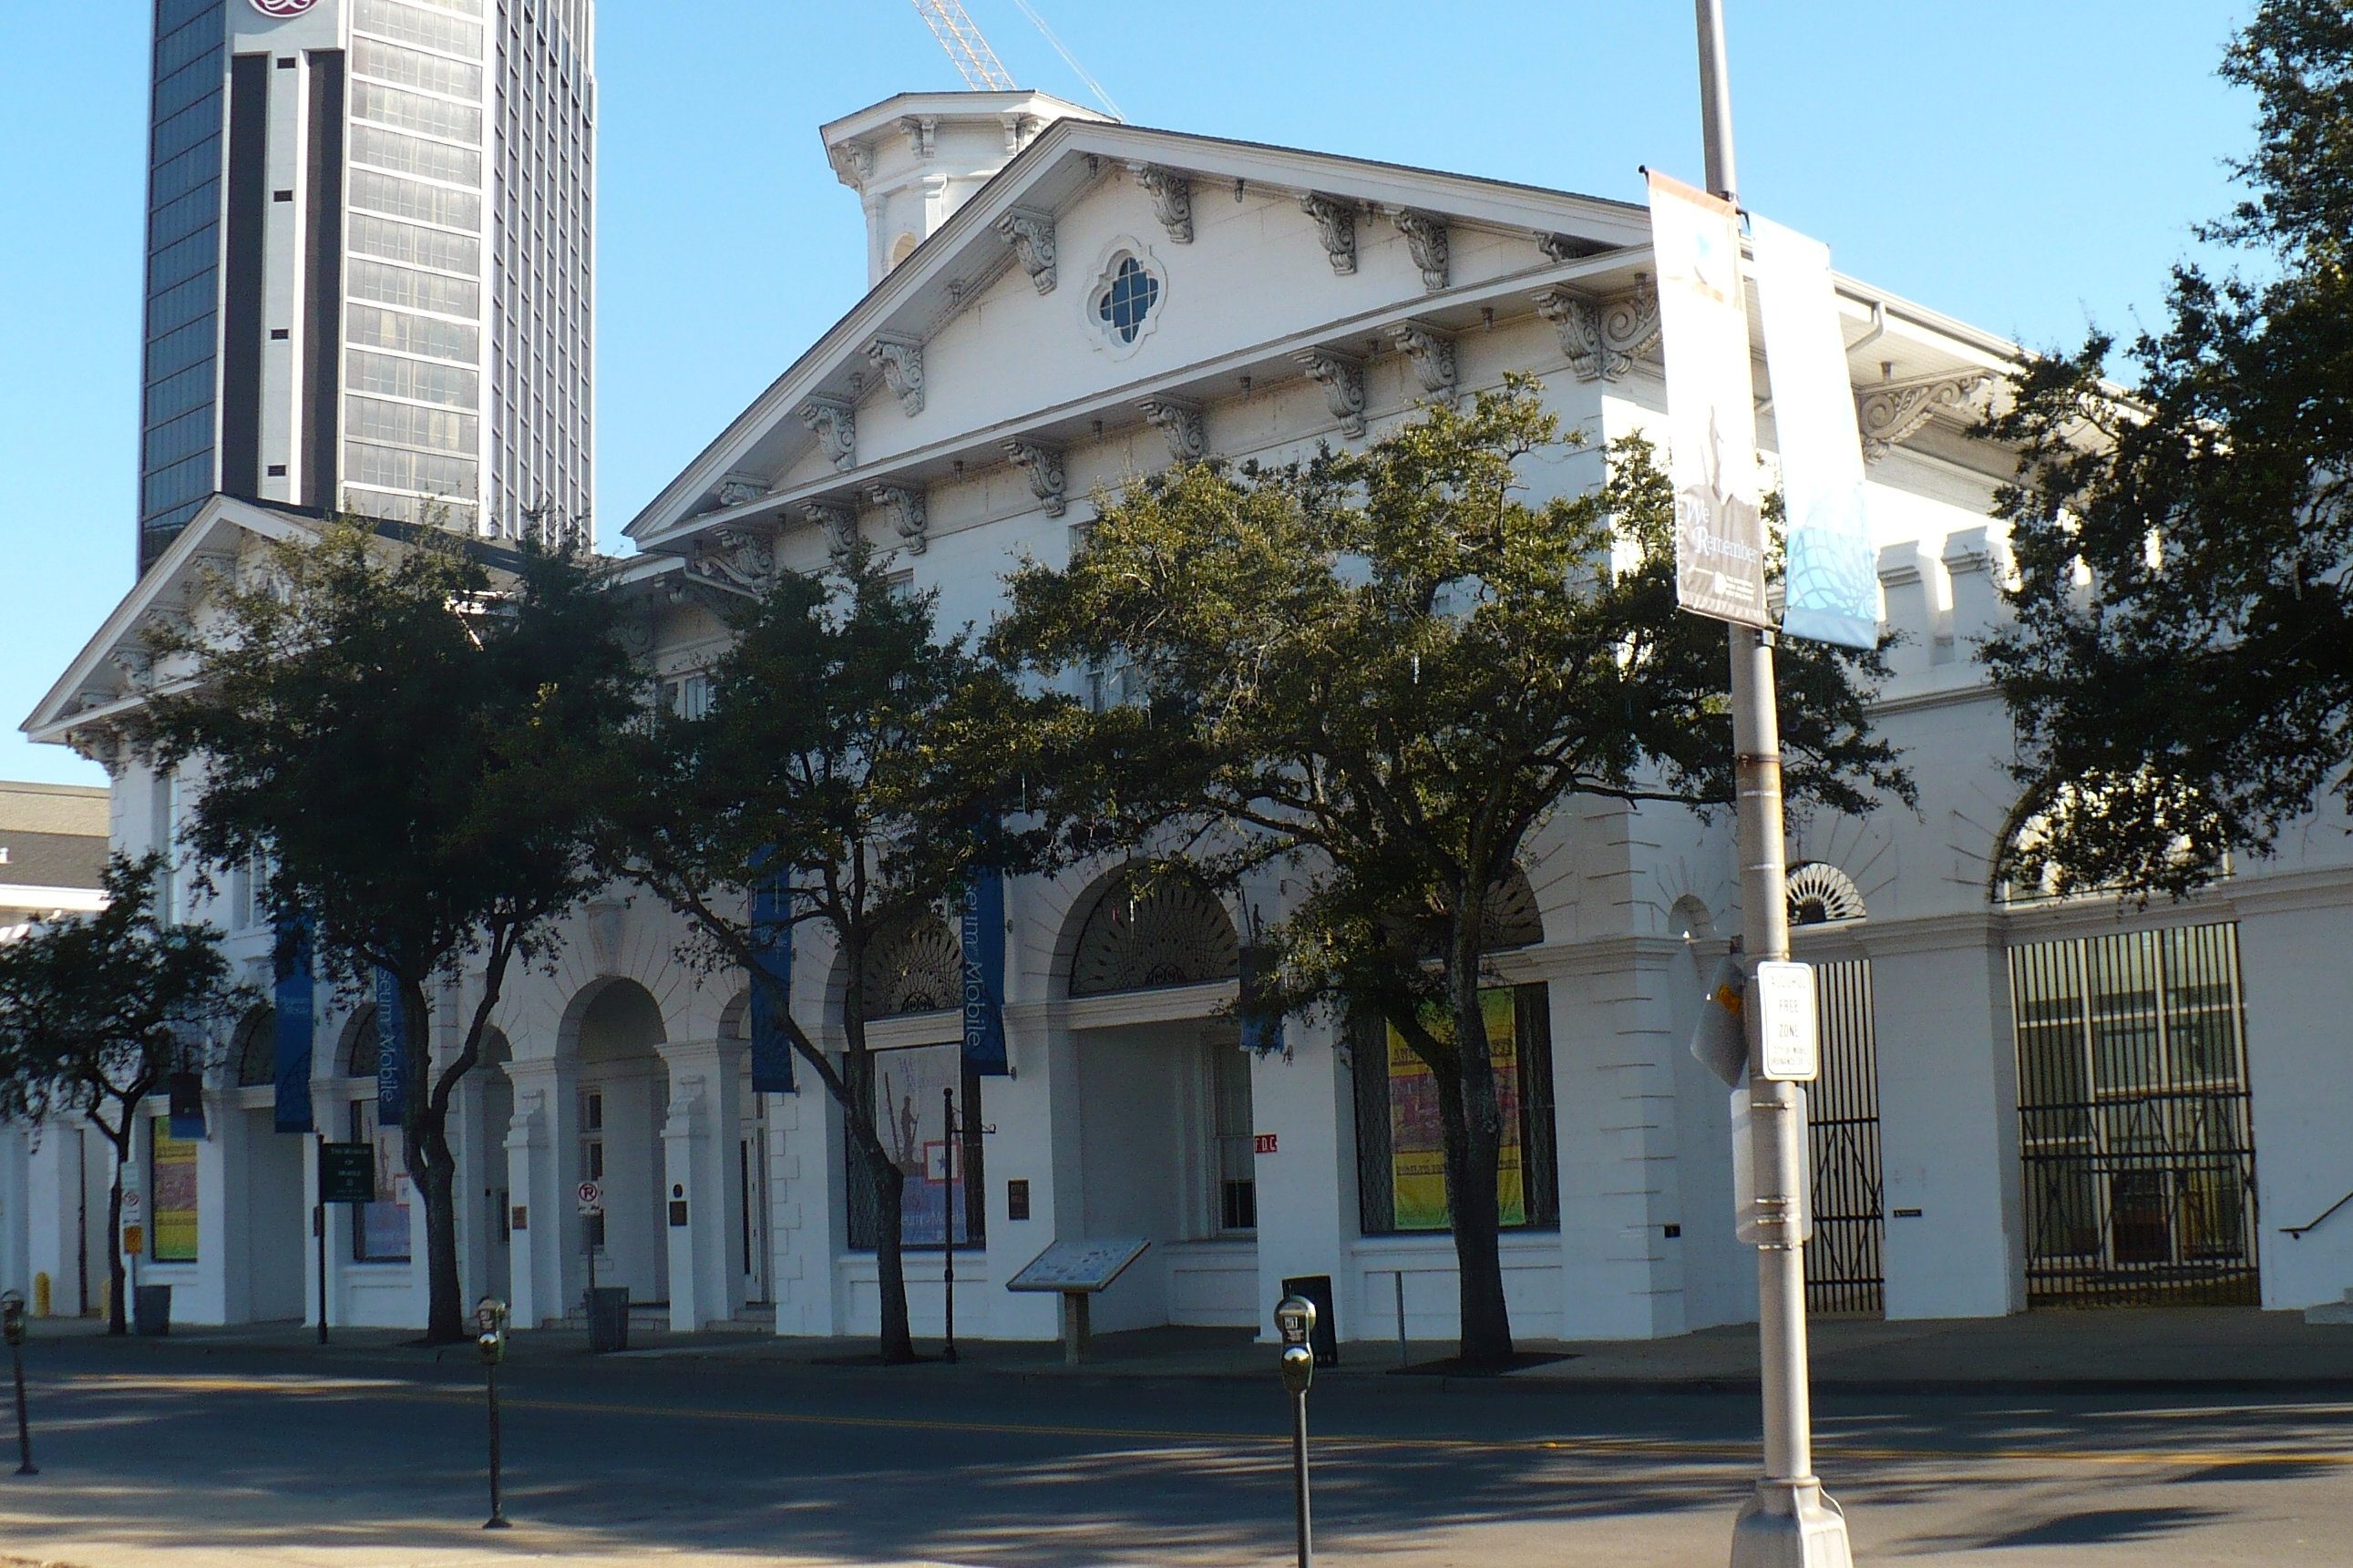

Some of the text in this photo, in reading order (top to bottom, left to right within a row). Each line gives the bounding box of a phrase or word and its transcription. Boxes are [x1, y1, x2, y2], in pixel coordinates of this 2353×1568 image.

[1685, 498, 1711, 525] We
[1692, 526, 1759, 564] Remember
[1771, 975, 1807, 989] ALCOHOL
[965, 961, 986, 1047] Mobile
[1779, 999, 1799, 1013] FREE
[1779, 1024, 1800, 1038] ZONE
[379, 1034, 398, 1102] Mobile
